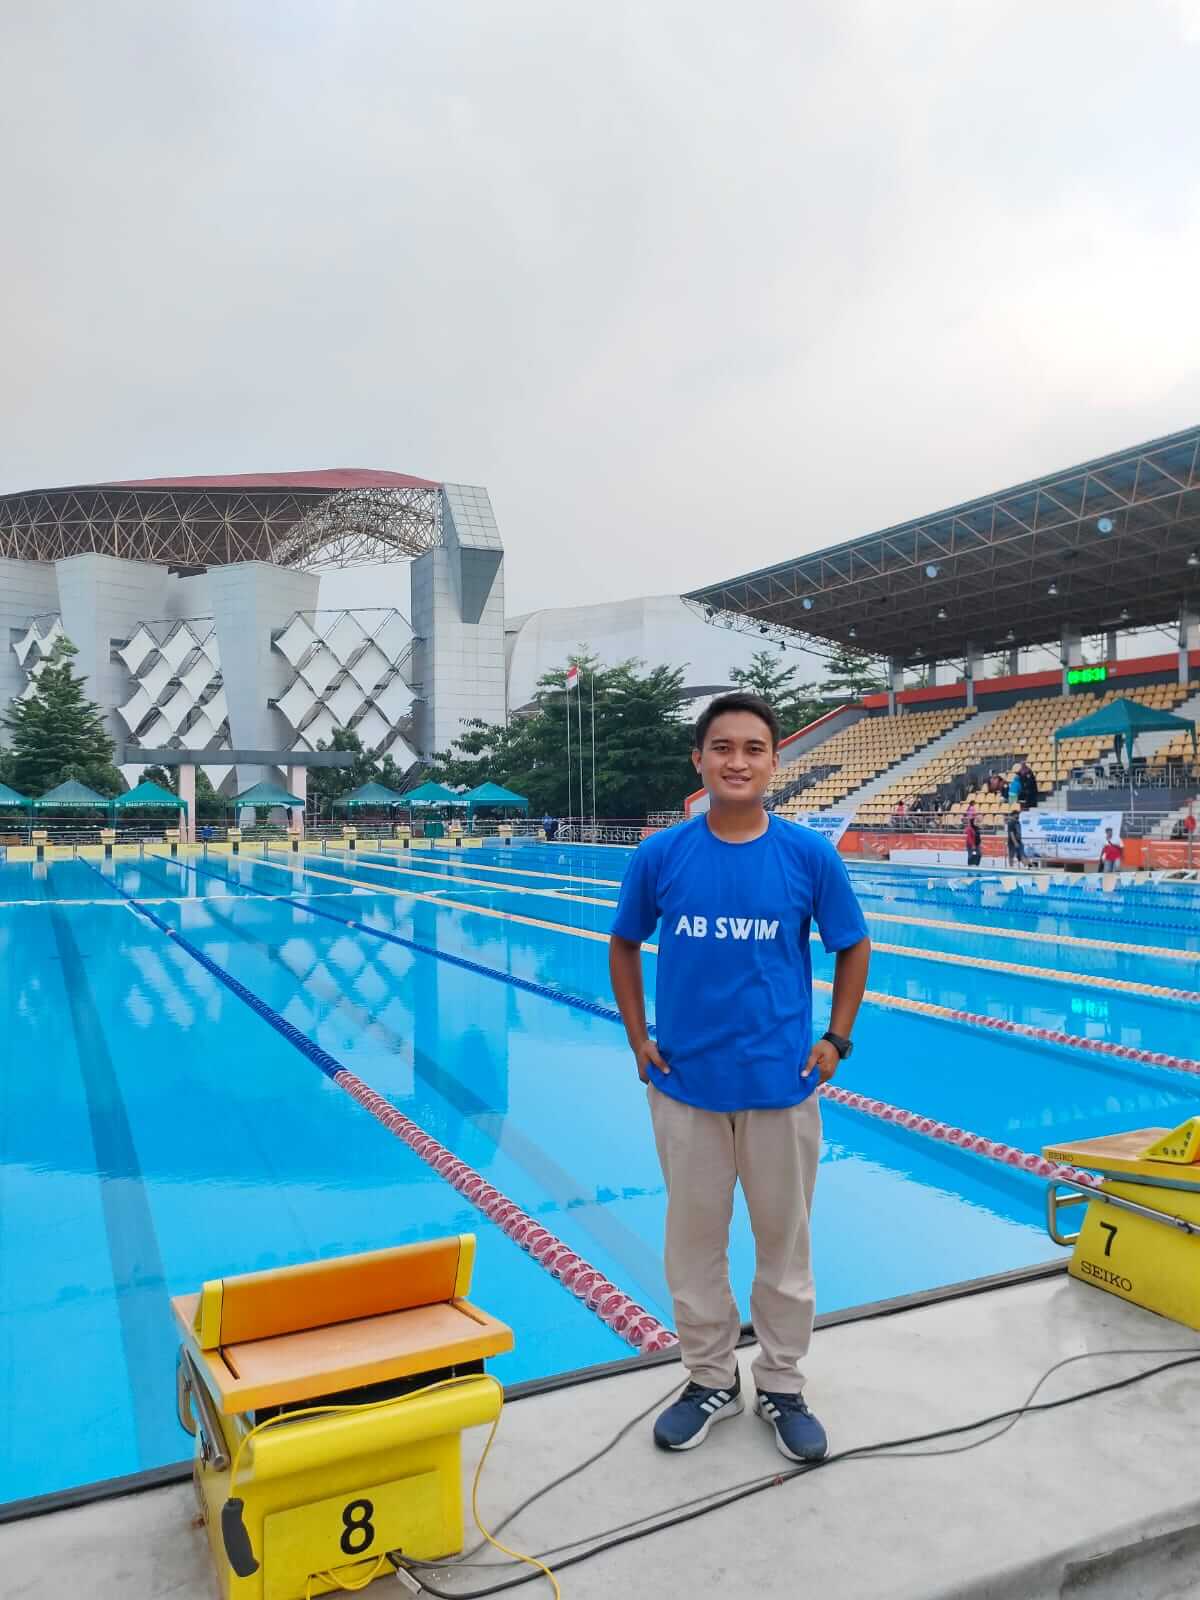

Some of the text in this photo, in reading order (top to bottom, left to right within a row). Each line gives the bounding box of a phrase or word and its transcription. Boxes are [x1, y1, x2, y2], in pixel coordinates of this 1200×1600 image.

[675, 915, 779, 940] AB SWIM
[1100, 1221, 1117, 1256] 7
[1081, 1261, 1132, 1292] SEIKO
[341, 1500, 373, 1554] 8
